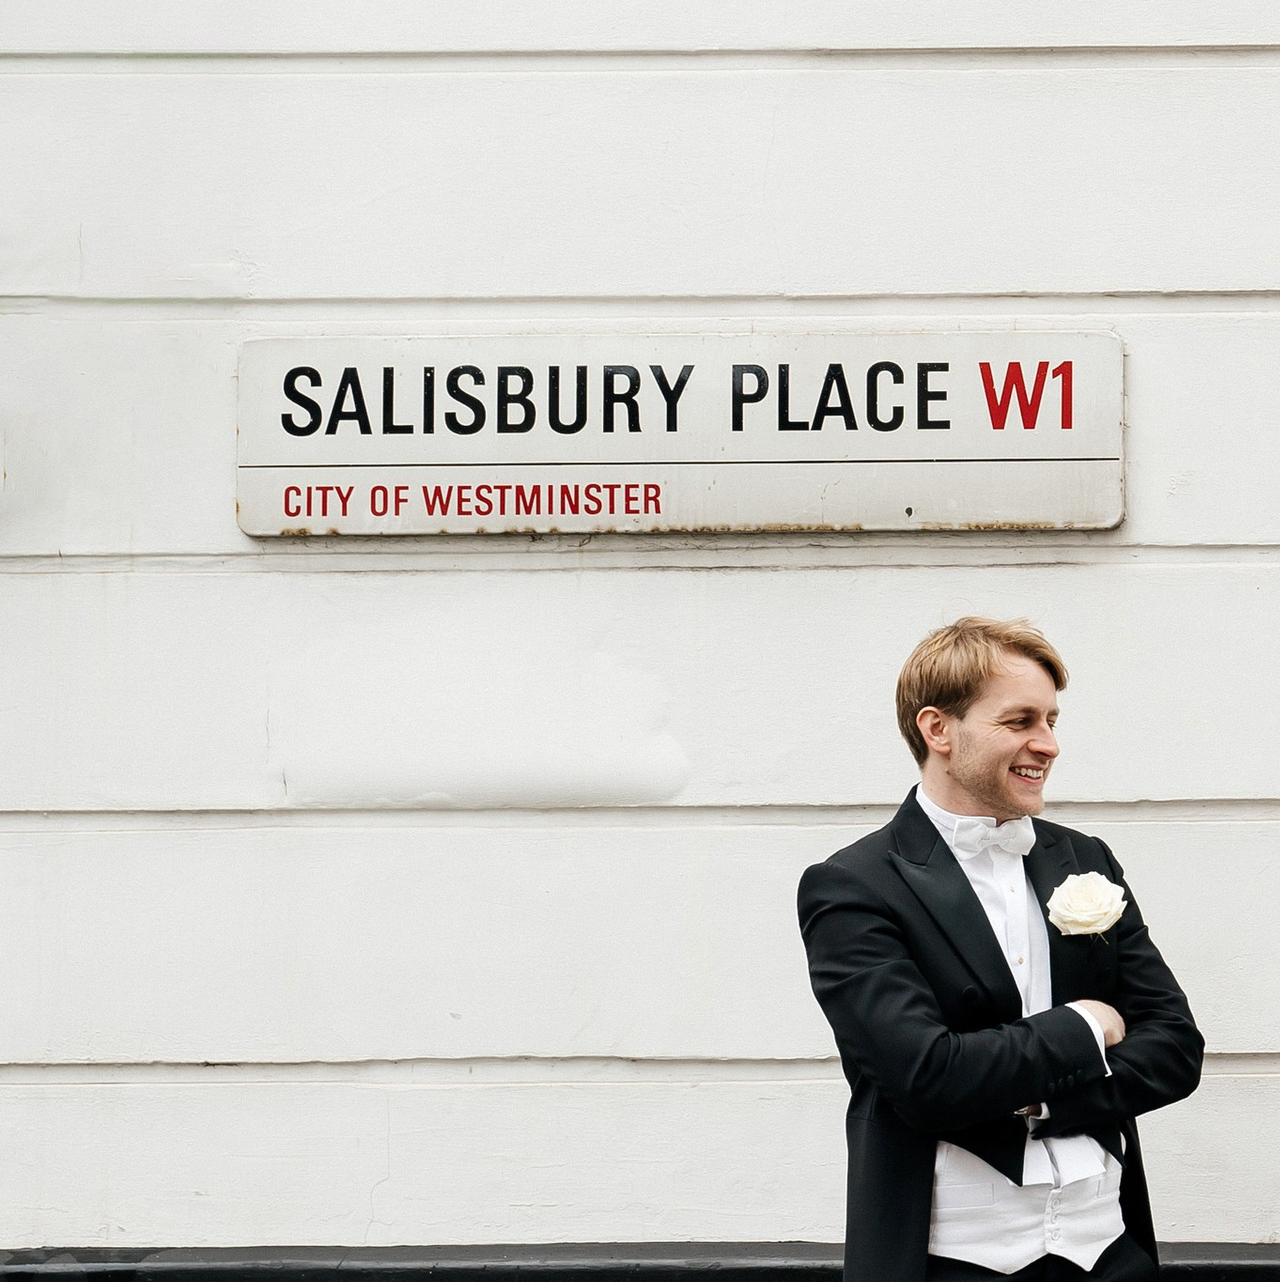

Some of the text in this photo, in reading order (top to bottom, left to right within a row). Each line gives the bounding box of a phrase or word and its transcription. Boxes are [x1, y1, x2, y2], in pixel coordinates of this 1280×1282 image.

[281, 360, 1074, 437] SALISBURY PLACE W1
[283, 483, 661, 517] CITY OF WESTMINSTER
